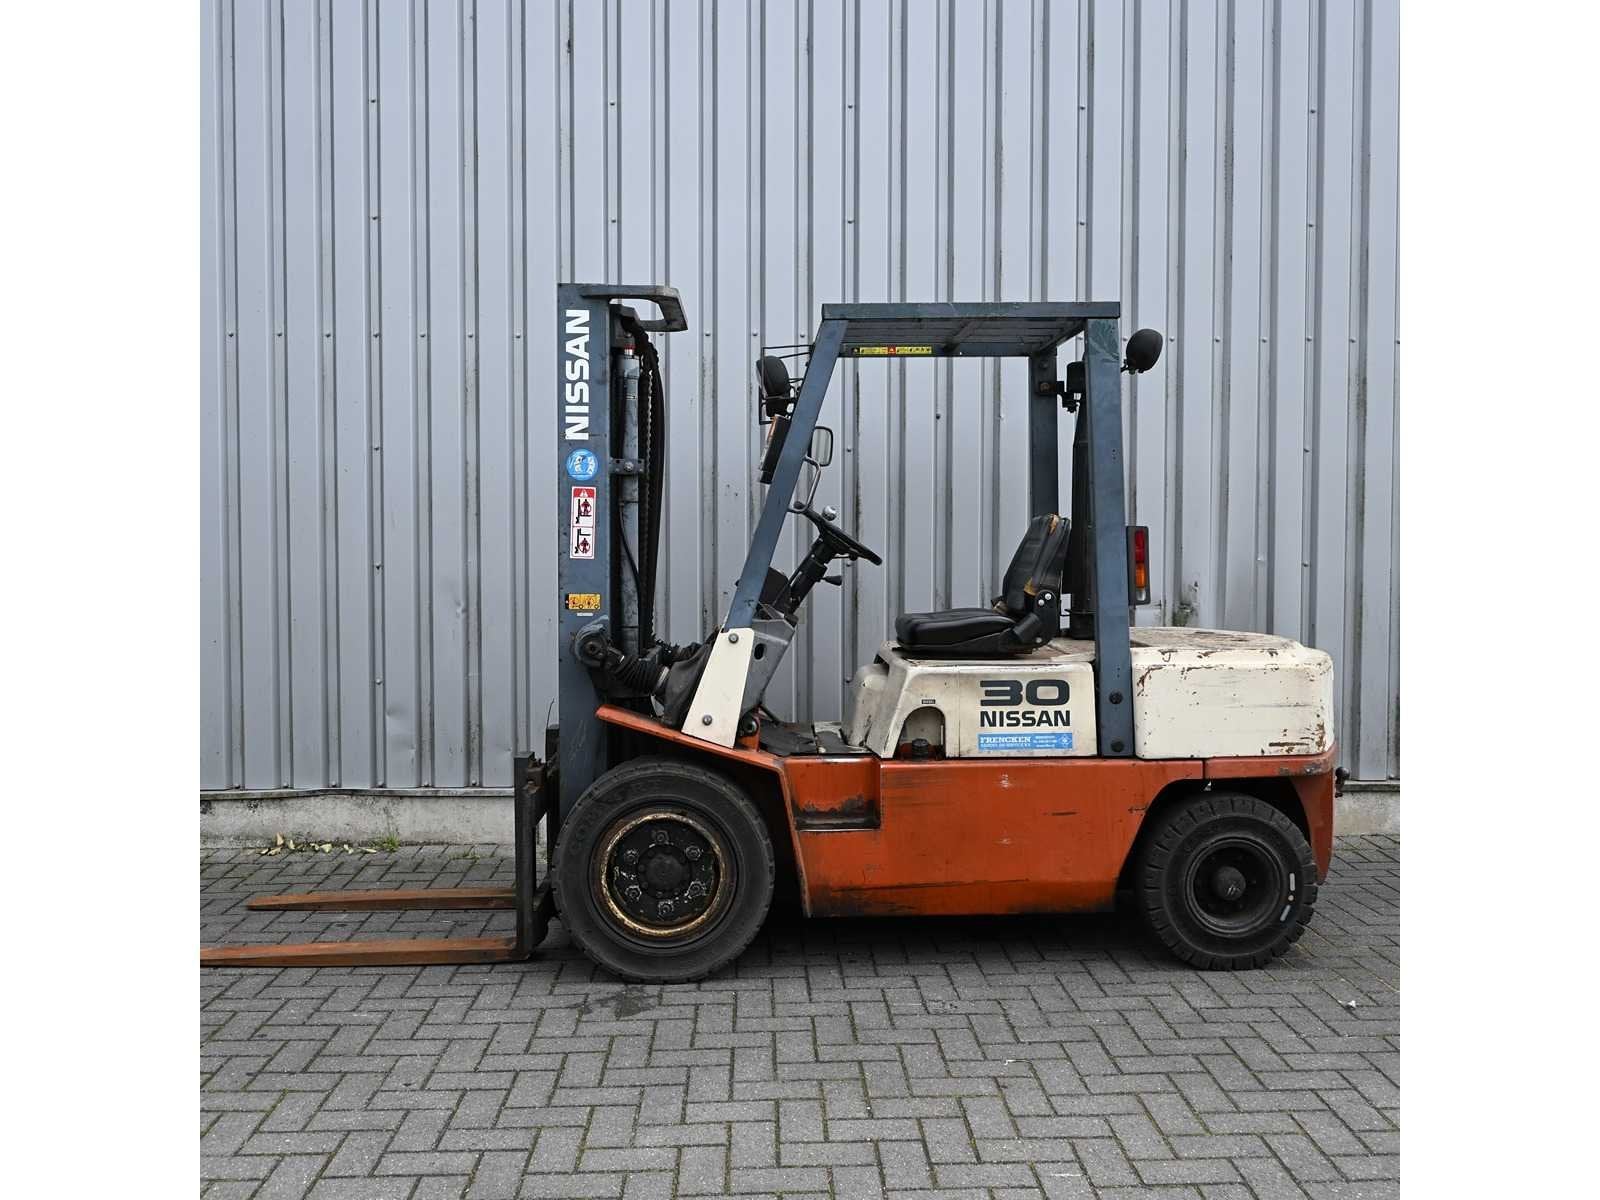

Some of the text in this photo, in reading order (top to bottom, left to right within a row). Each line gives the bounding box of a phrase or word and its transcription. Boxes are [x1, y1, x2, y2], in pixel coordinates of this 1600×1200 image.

[565, 309, 590, 441] NISSAN
[980, 679, 1070, 706] 30
[980, 710, 1070, 727] NISSAN
